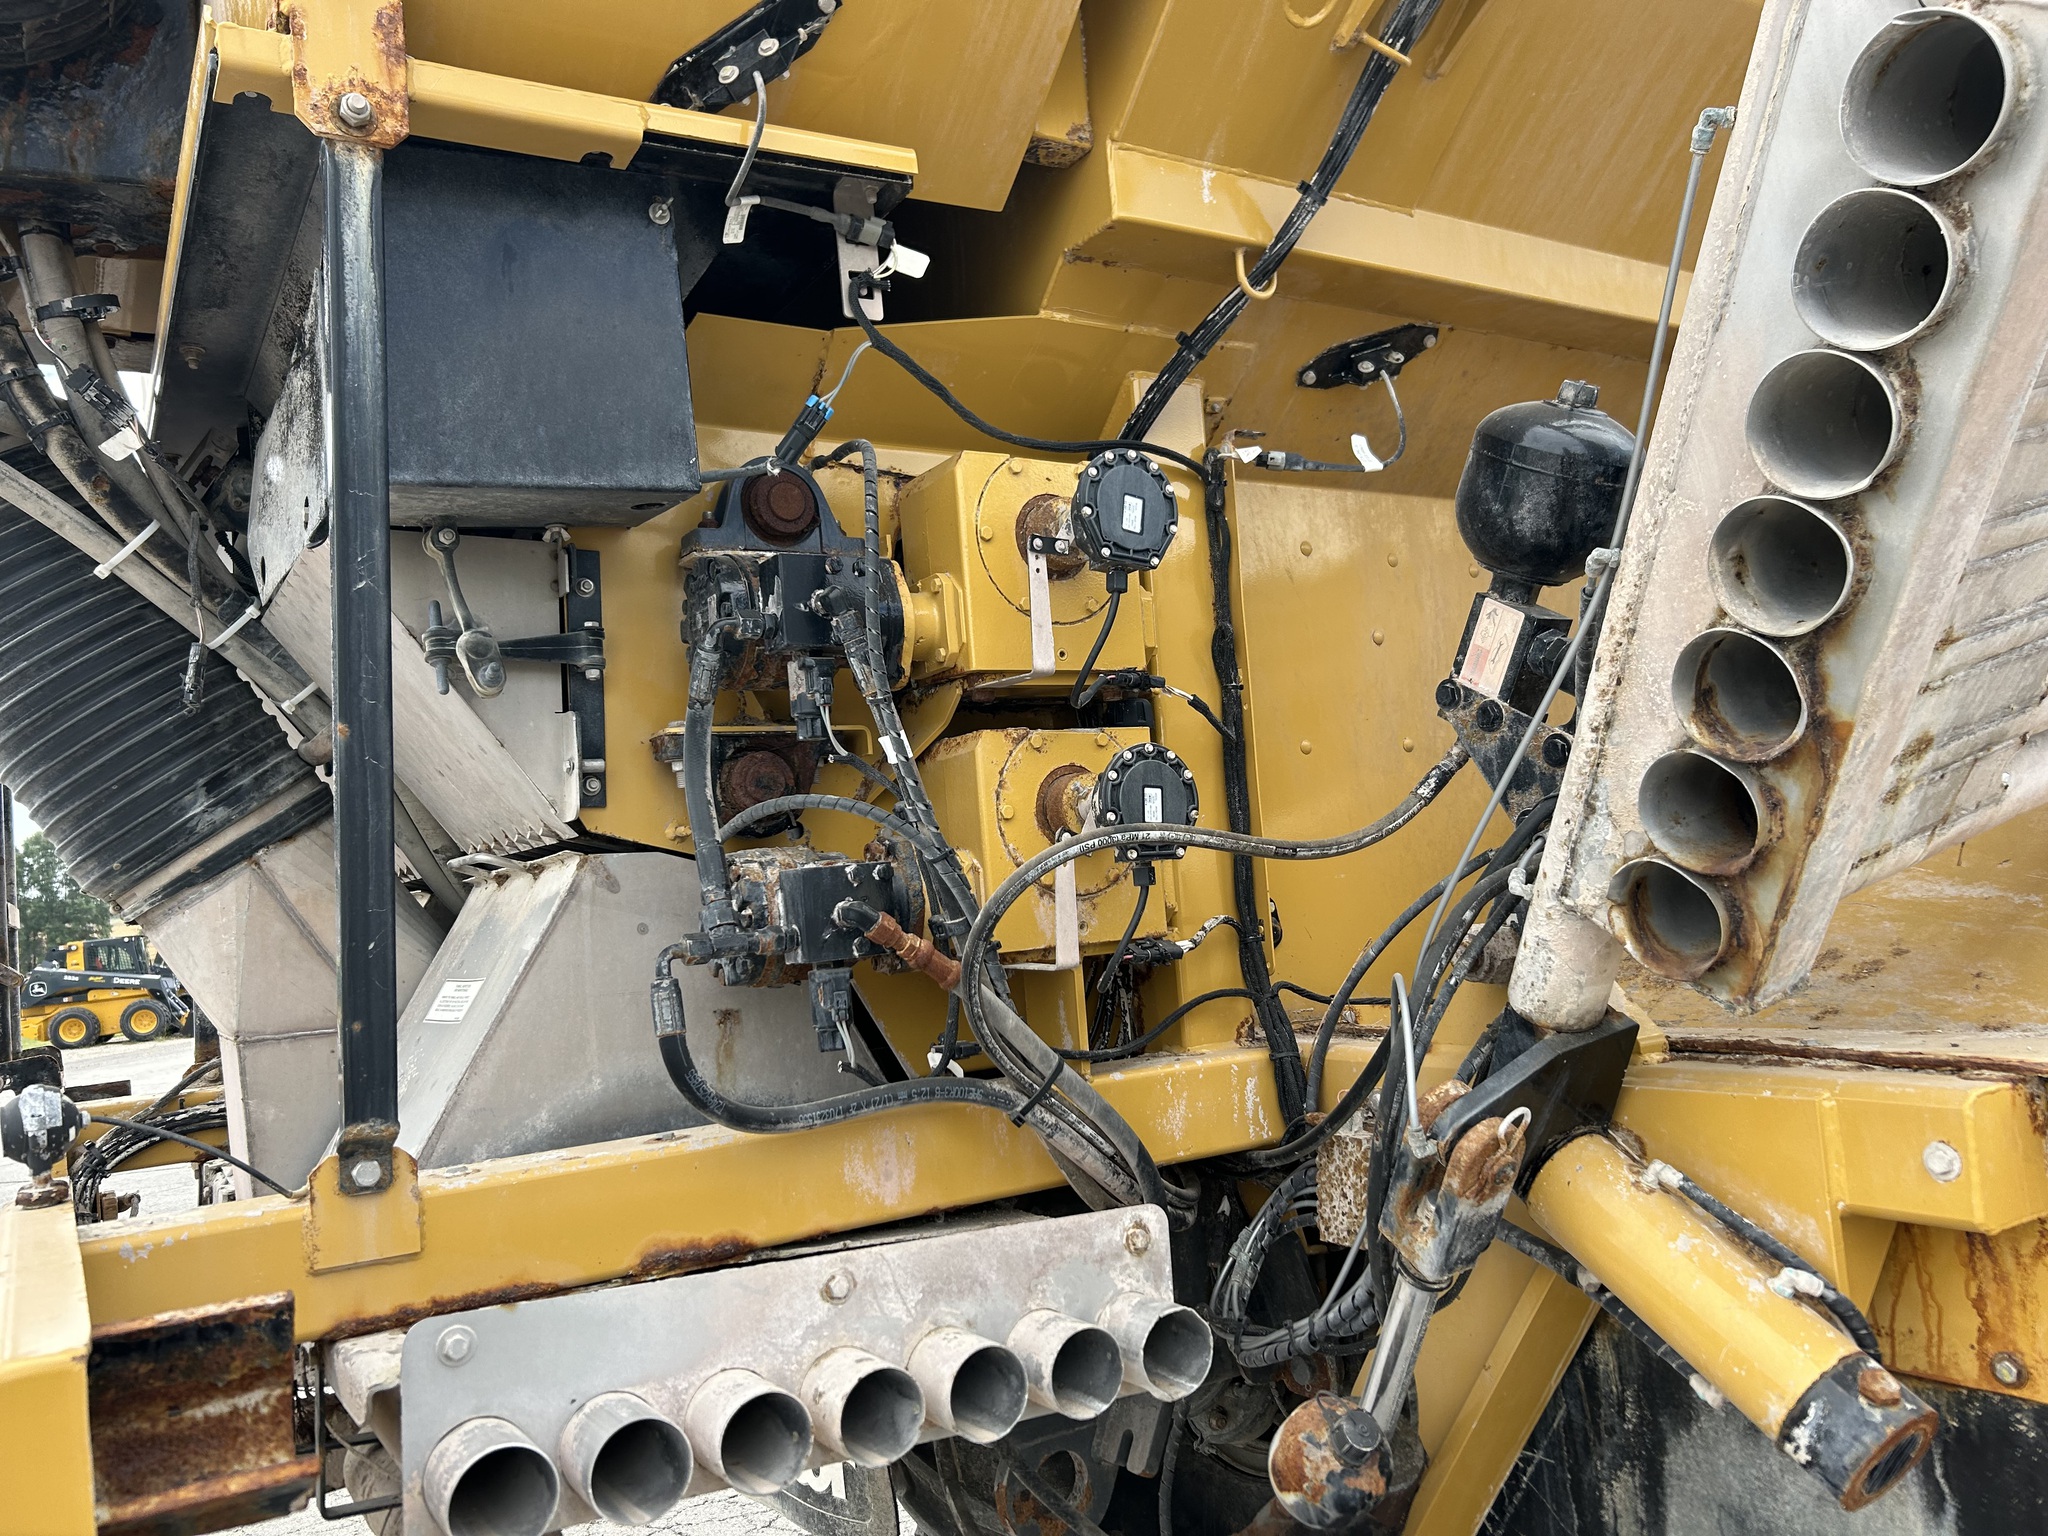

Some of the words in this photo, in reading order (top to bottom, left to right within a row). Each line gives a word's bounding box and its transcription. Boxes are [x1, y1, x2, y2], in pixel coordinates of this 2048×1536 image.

[1120, 832, 1140, 841] MPa
[1141, 832, 1151, 840] 21
[113, 976, 141, 985] DEERE
[911, 1086, 930, 1100] 12.5
